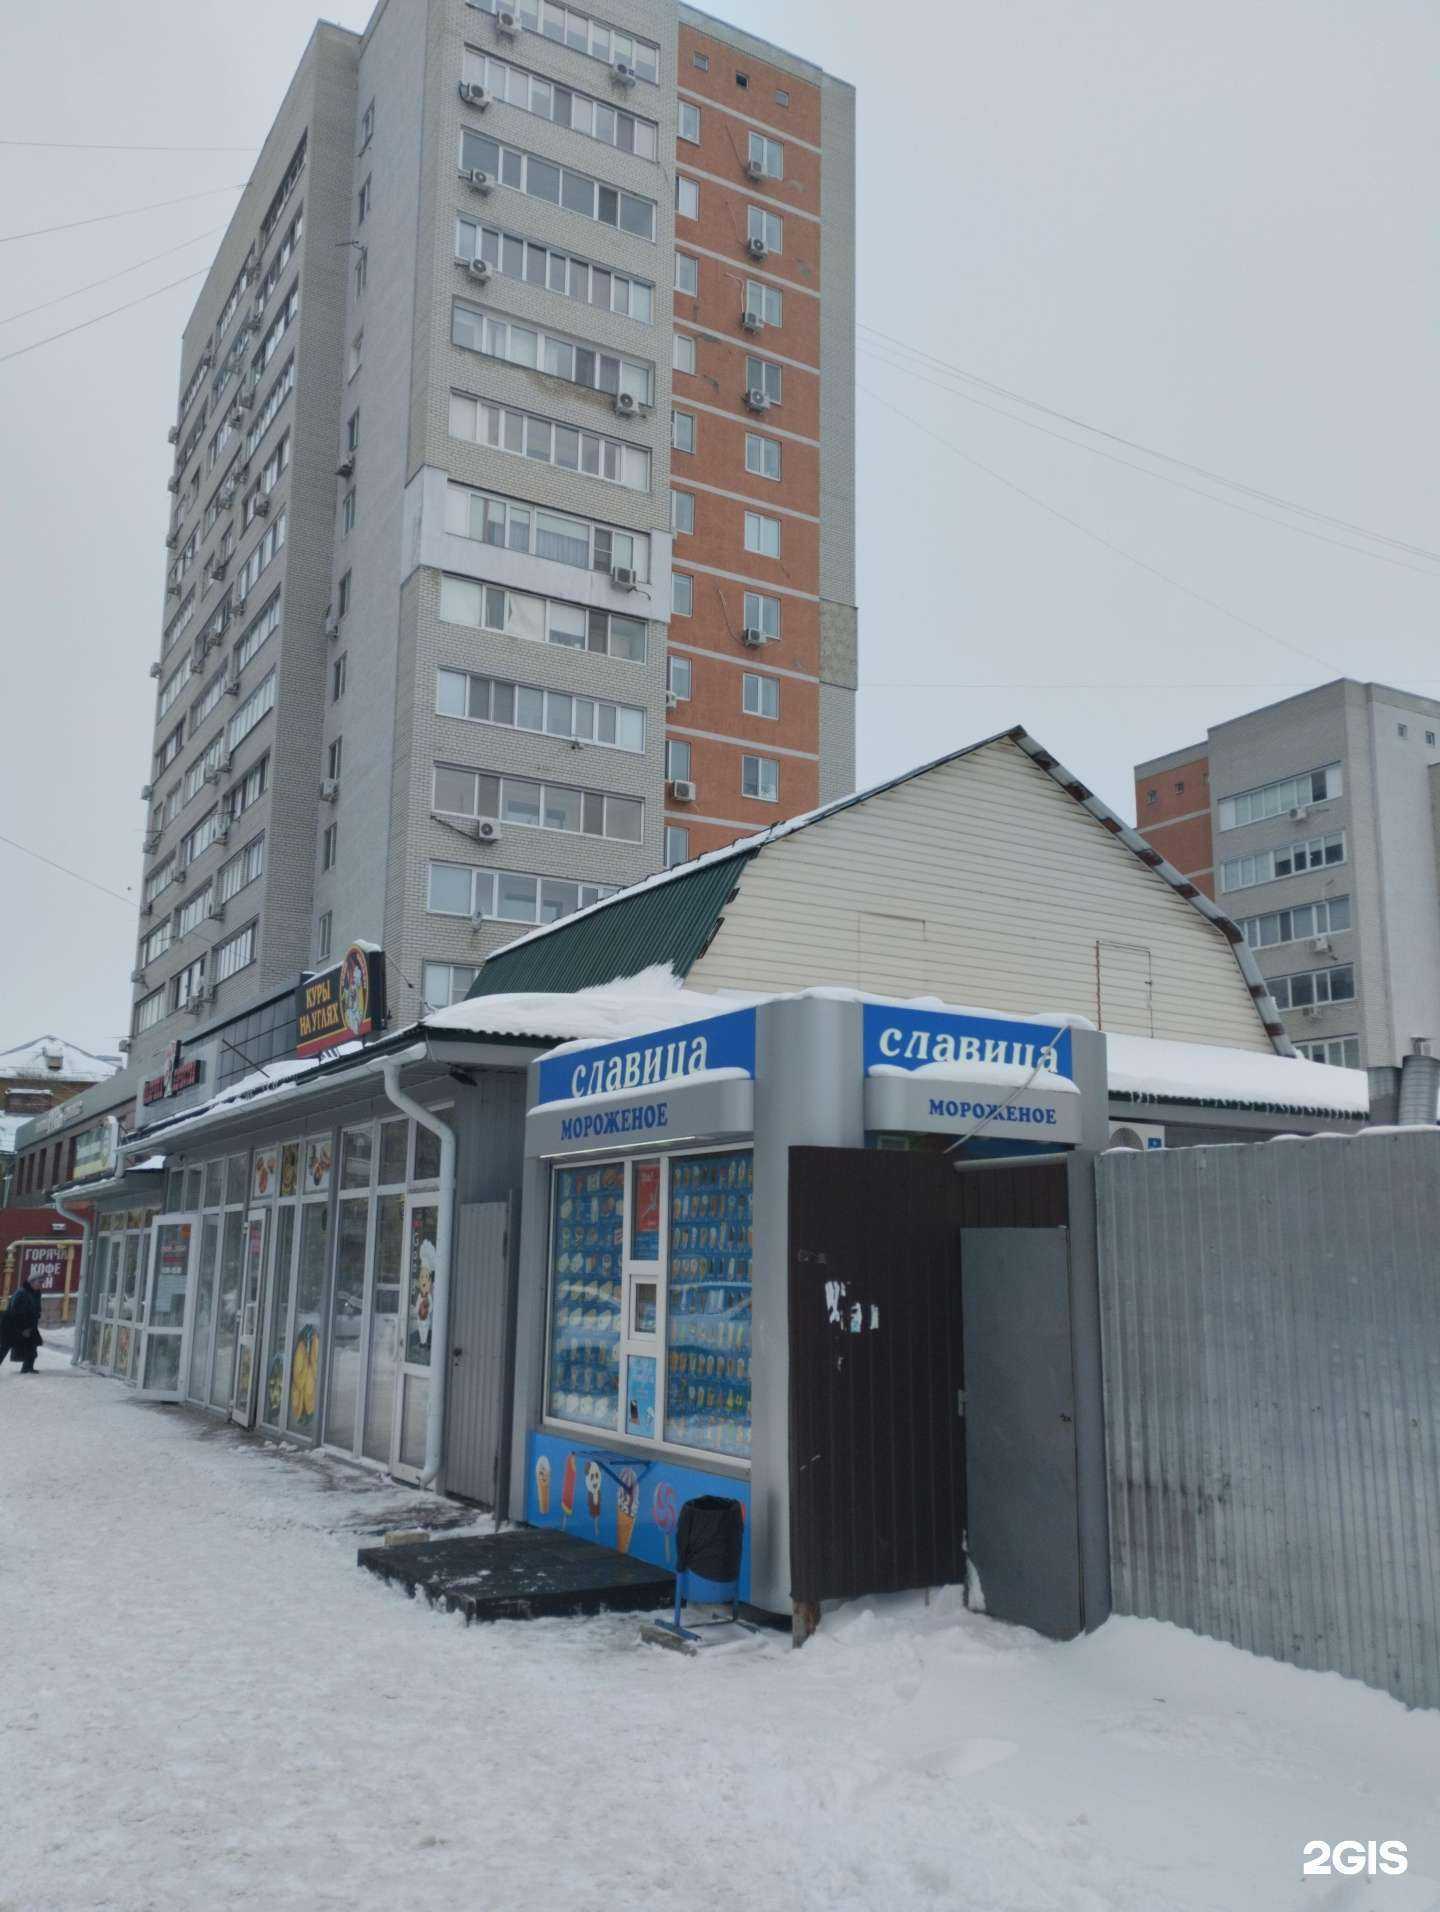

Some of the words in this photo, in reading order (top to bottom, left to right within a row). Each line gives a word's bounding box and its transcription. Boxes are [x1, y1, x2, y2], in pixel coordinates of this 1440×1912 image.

[306, 979, 331, 1009] КУРЫ
[300, 1013, 312, 1037] НА
[312, 1003, 338, 1032] УГЛЯХ
[561, 1103, 668, 1140] МОРОЖЕНОЕ
[928, 1099, 1057, 1124] МОРОЖЕНОЕ
[31, 1262, 61, 1275] КОФЕ
